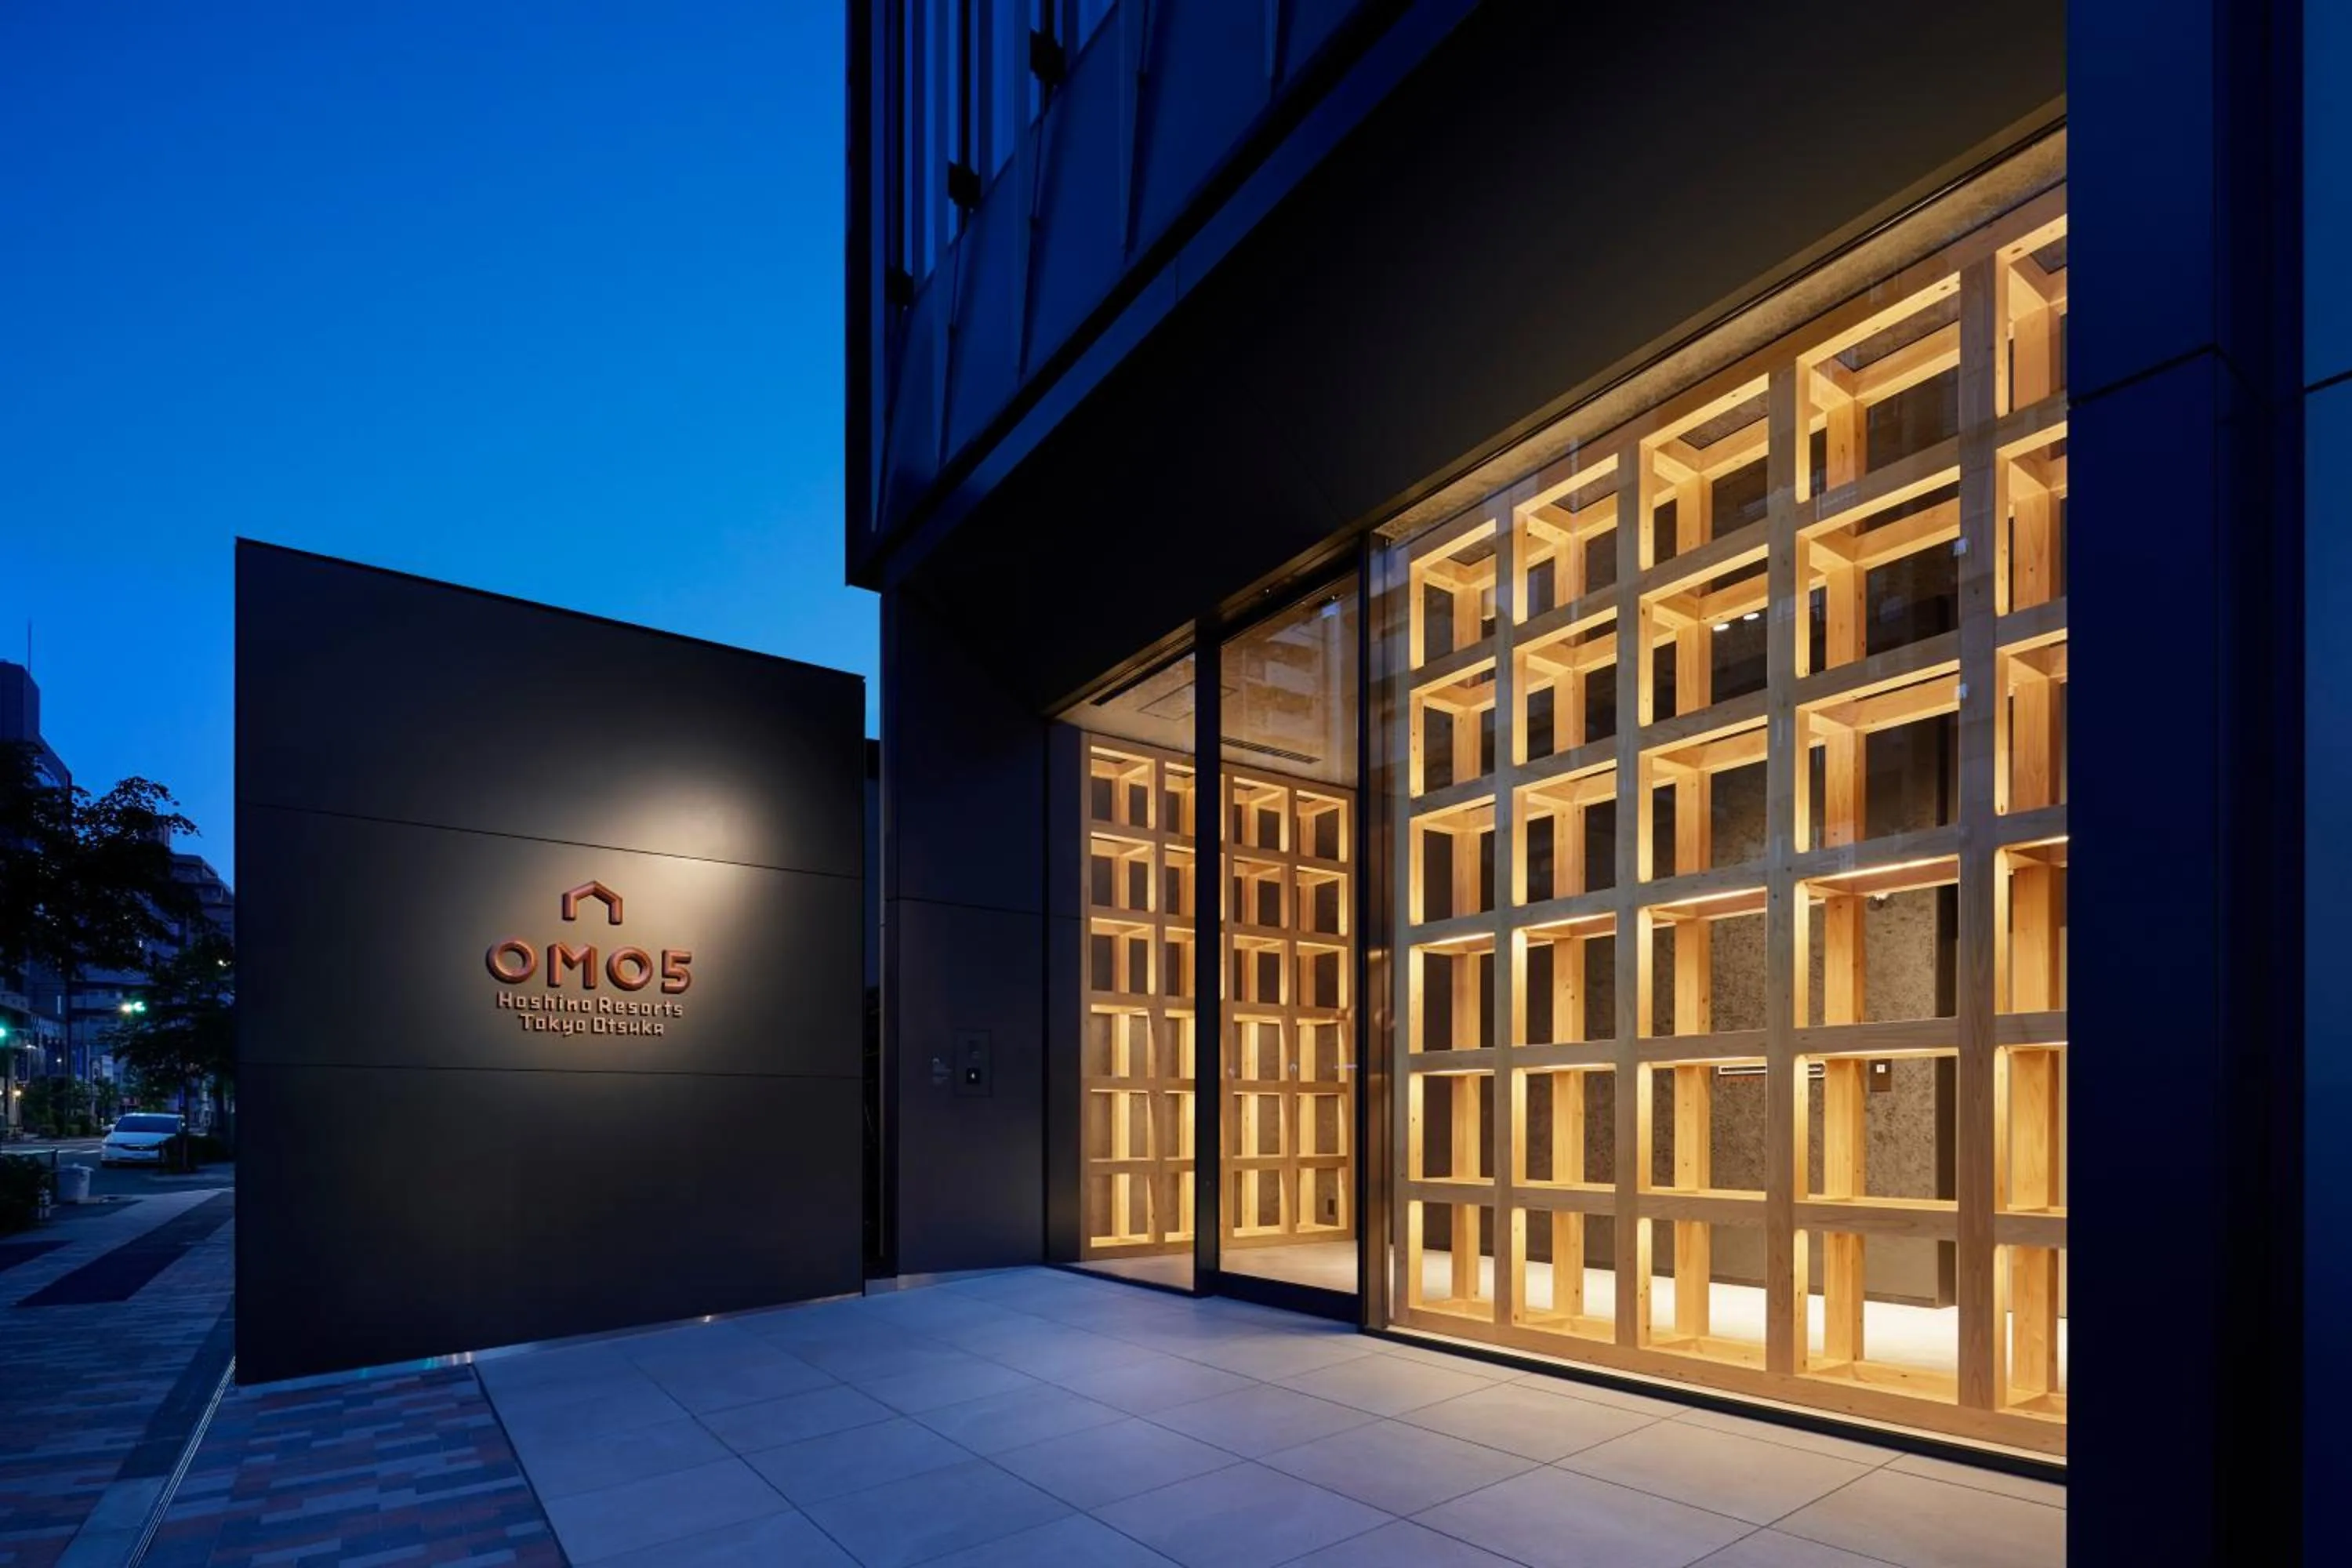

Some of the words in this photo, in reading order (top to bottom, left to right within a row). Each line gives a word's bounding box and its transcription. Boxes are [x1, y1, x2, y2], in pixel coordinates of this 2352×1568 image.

[487, 940, 691, 993] OMO5
[497, 992, 591, 1012] Hoshino
[597, 997, 684, 1017] Resorts
[519, 1014, 586, 1036] Tokyo
[591, 1018, 665, 1036] Otsuka
